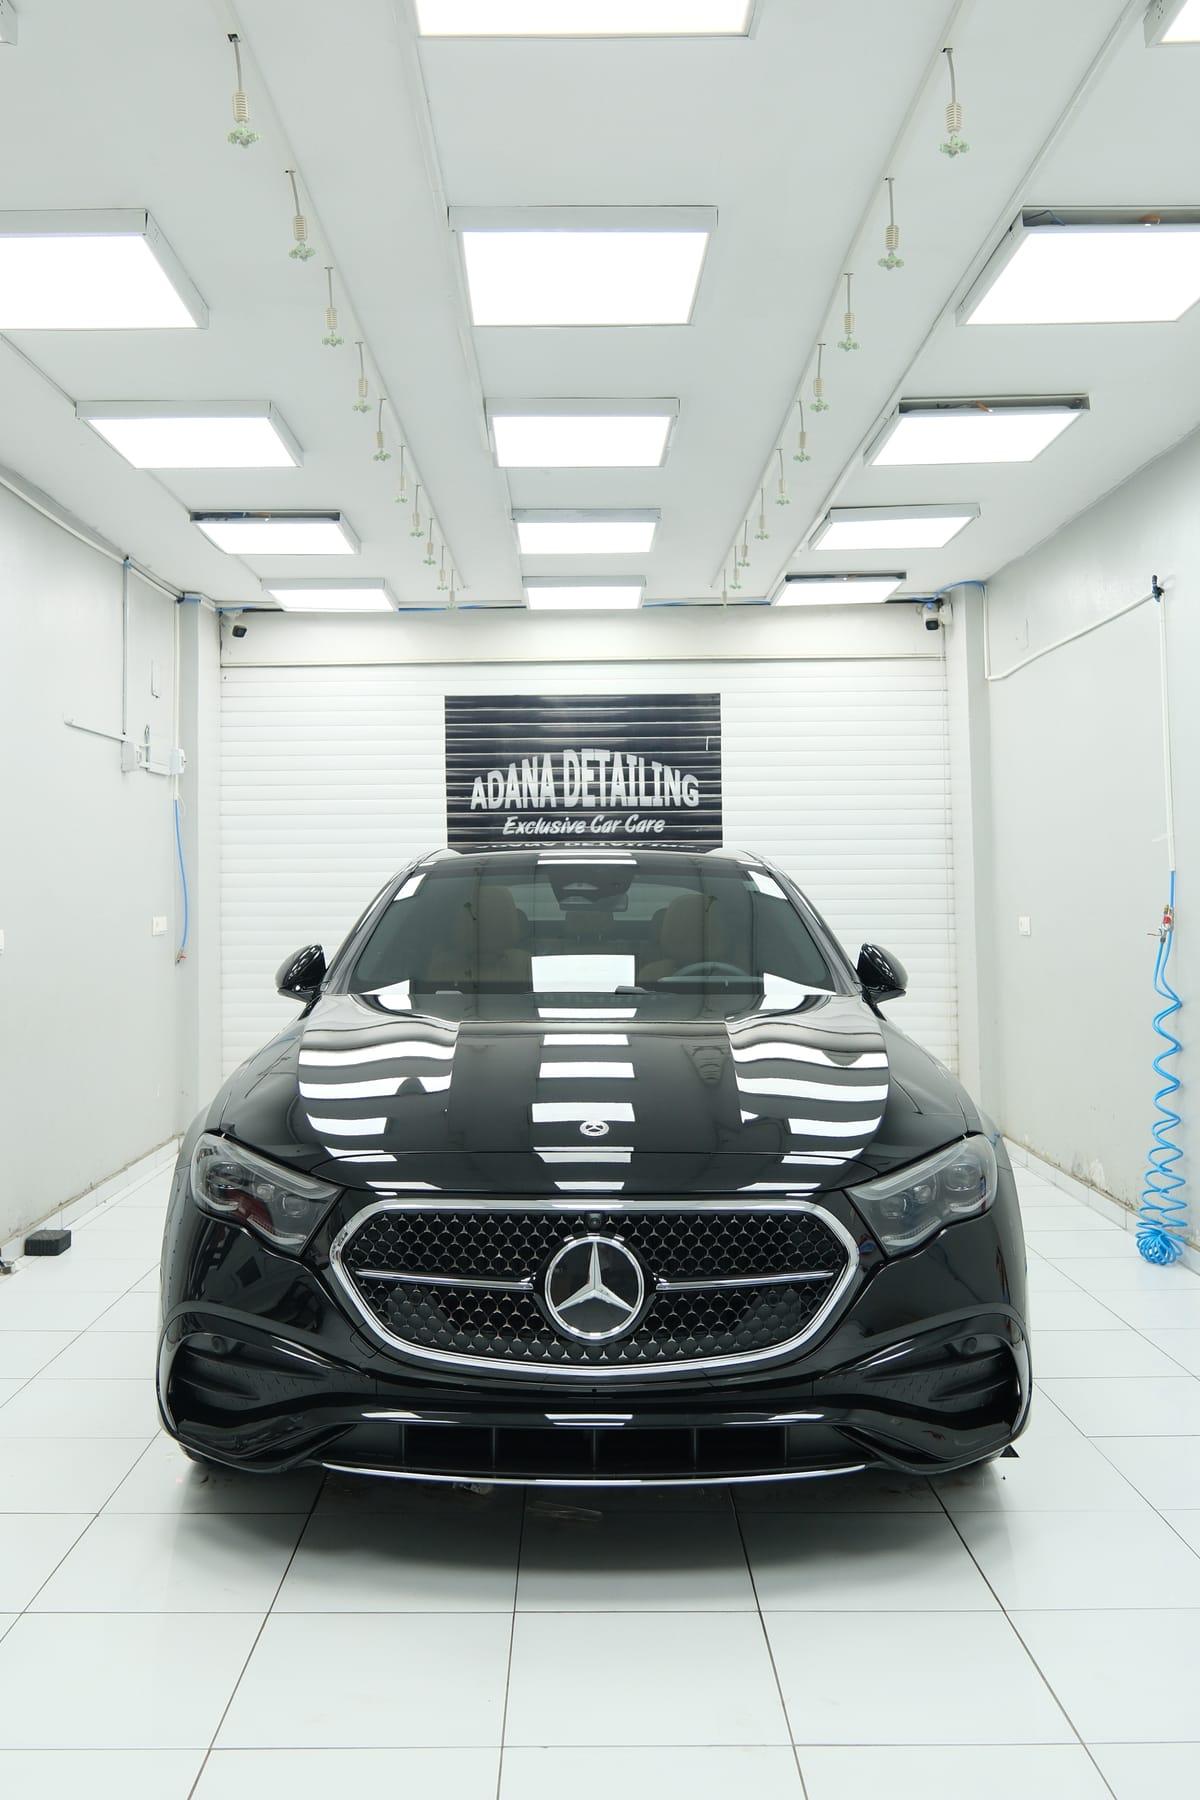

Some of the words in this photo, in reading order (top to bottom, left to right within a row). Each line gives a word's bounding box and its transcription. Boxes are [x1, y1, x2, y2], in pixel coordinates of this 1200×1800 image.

[470, 753, 556, 810] ADANA
[562, 748, 699, 808] DETAILING
[503, 815, 586, 835] Exclusive
[590, 815, 621, 834] Car
[625, 814, 665, 833] Care
